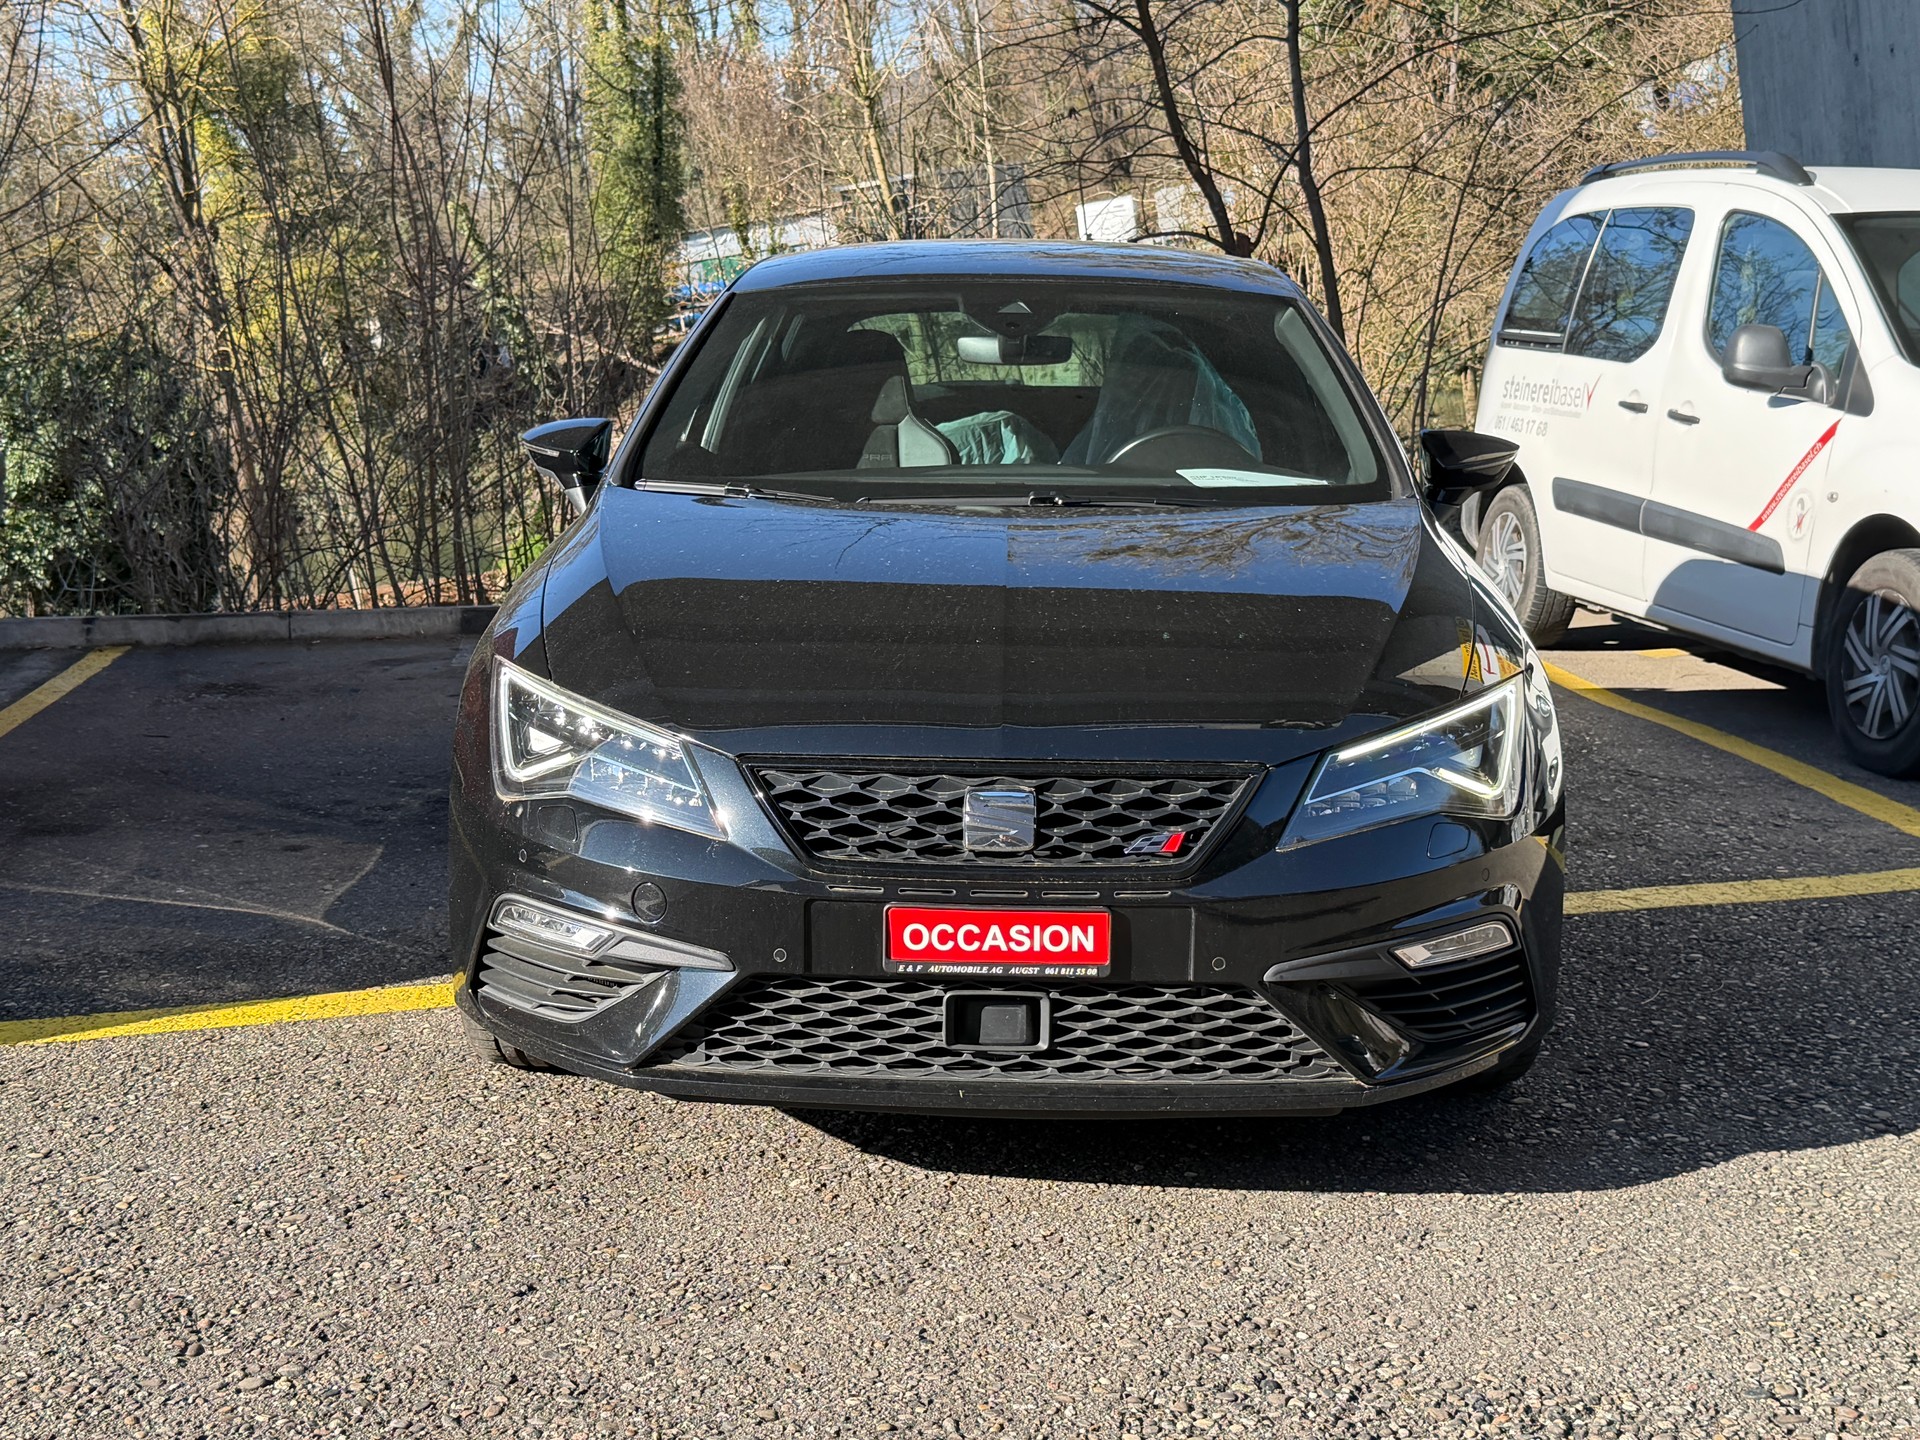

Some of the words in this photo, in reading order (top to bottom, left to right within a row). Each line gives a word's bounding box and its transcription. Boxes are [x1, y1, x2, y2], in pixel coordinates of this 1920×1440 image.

[1502, 376, 1585, 409] steinereibasel
[1525, 419, 1536, 434] 17
[1536, 421, 1548, 437] 68
[1761, 441, 1823, 521] www.steinereibasel.ch
[903, 923, 1095, 952] OCCASION
[906, 965, 914, 973] &
[915, 965, 924, 973] F
[927, 965, 989, 974] AUTOMOBILE
[989, 966, 1003, 974] AG
[1009, 967, 1040, 975] AUGST
[1045, 967, 1059, 975] 061
[1086, 968, 1098, 976] 00
